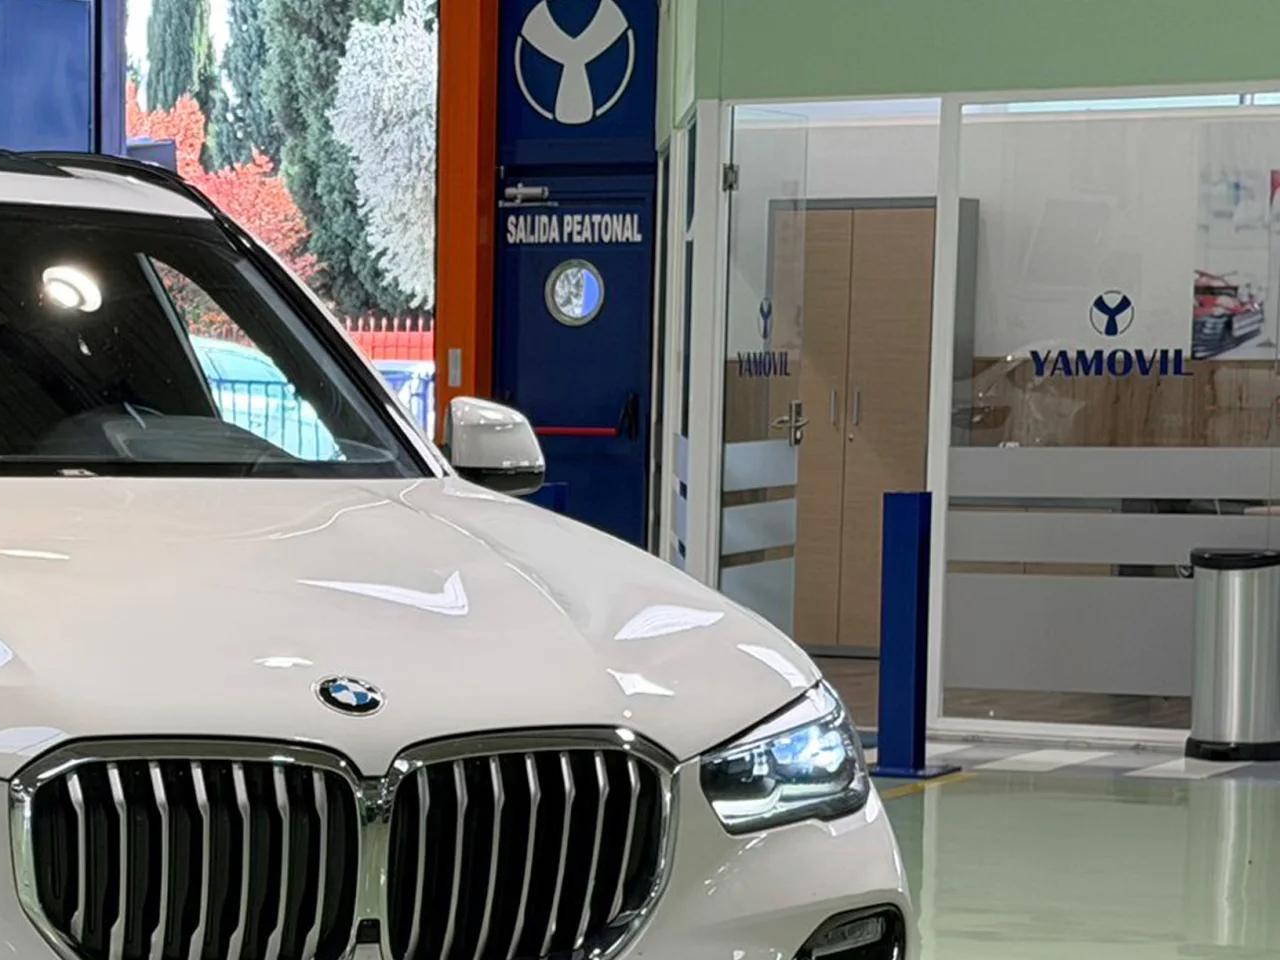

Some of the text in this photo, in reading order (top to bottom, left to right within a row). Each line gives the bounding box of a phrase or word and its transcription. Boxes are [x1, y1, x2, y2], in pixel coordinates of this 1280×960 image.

[506, 213, 642, 244] SALIDA PEATONAL
[737, 351, 791, 377] YAMOVIL
[1029, 349, 1194, 376] YAMOVIL
